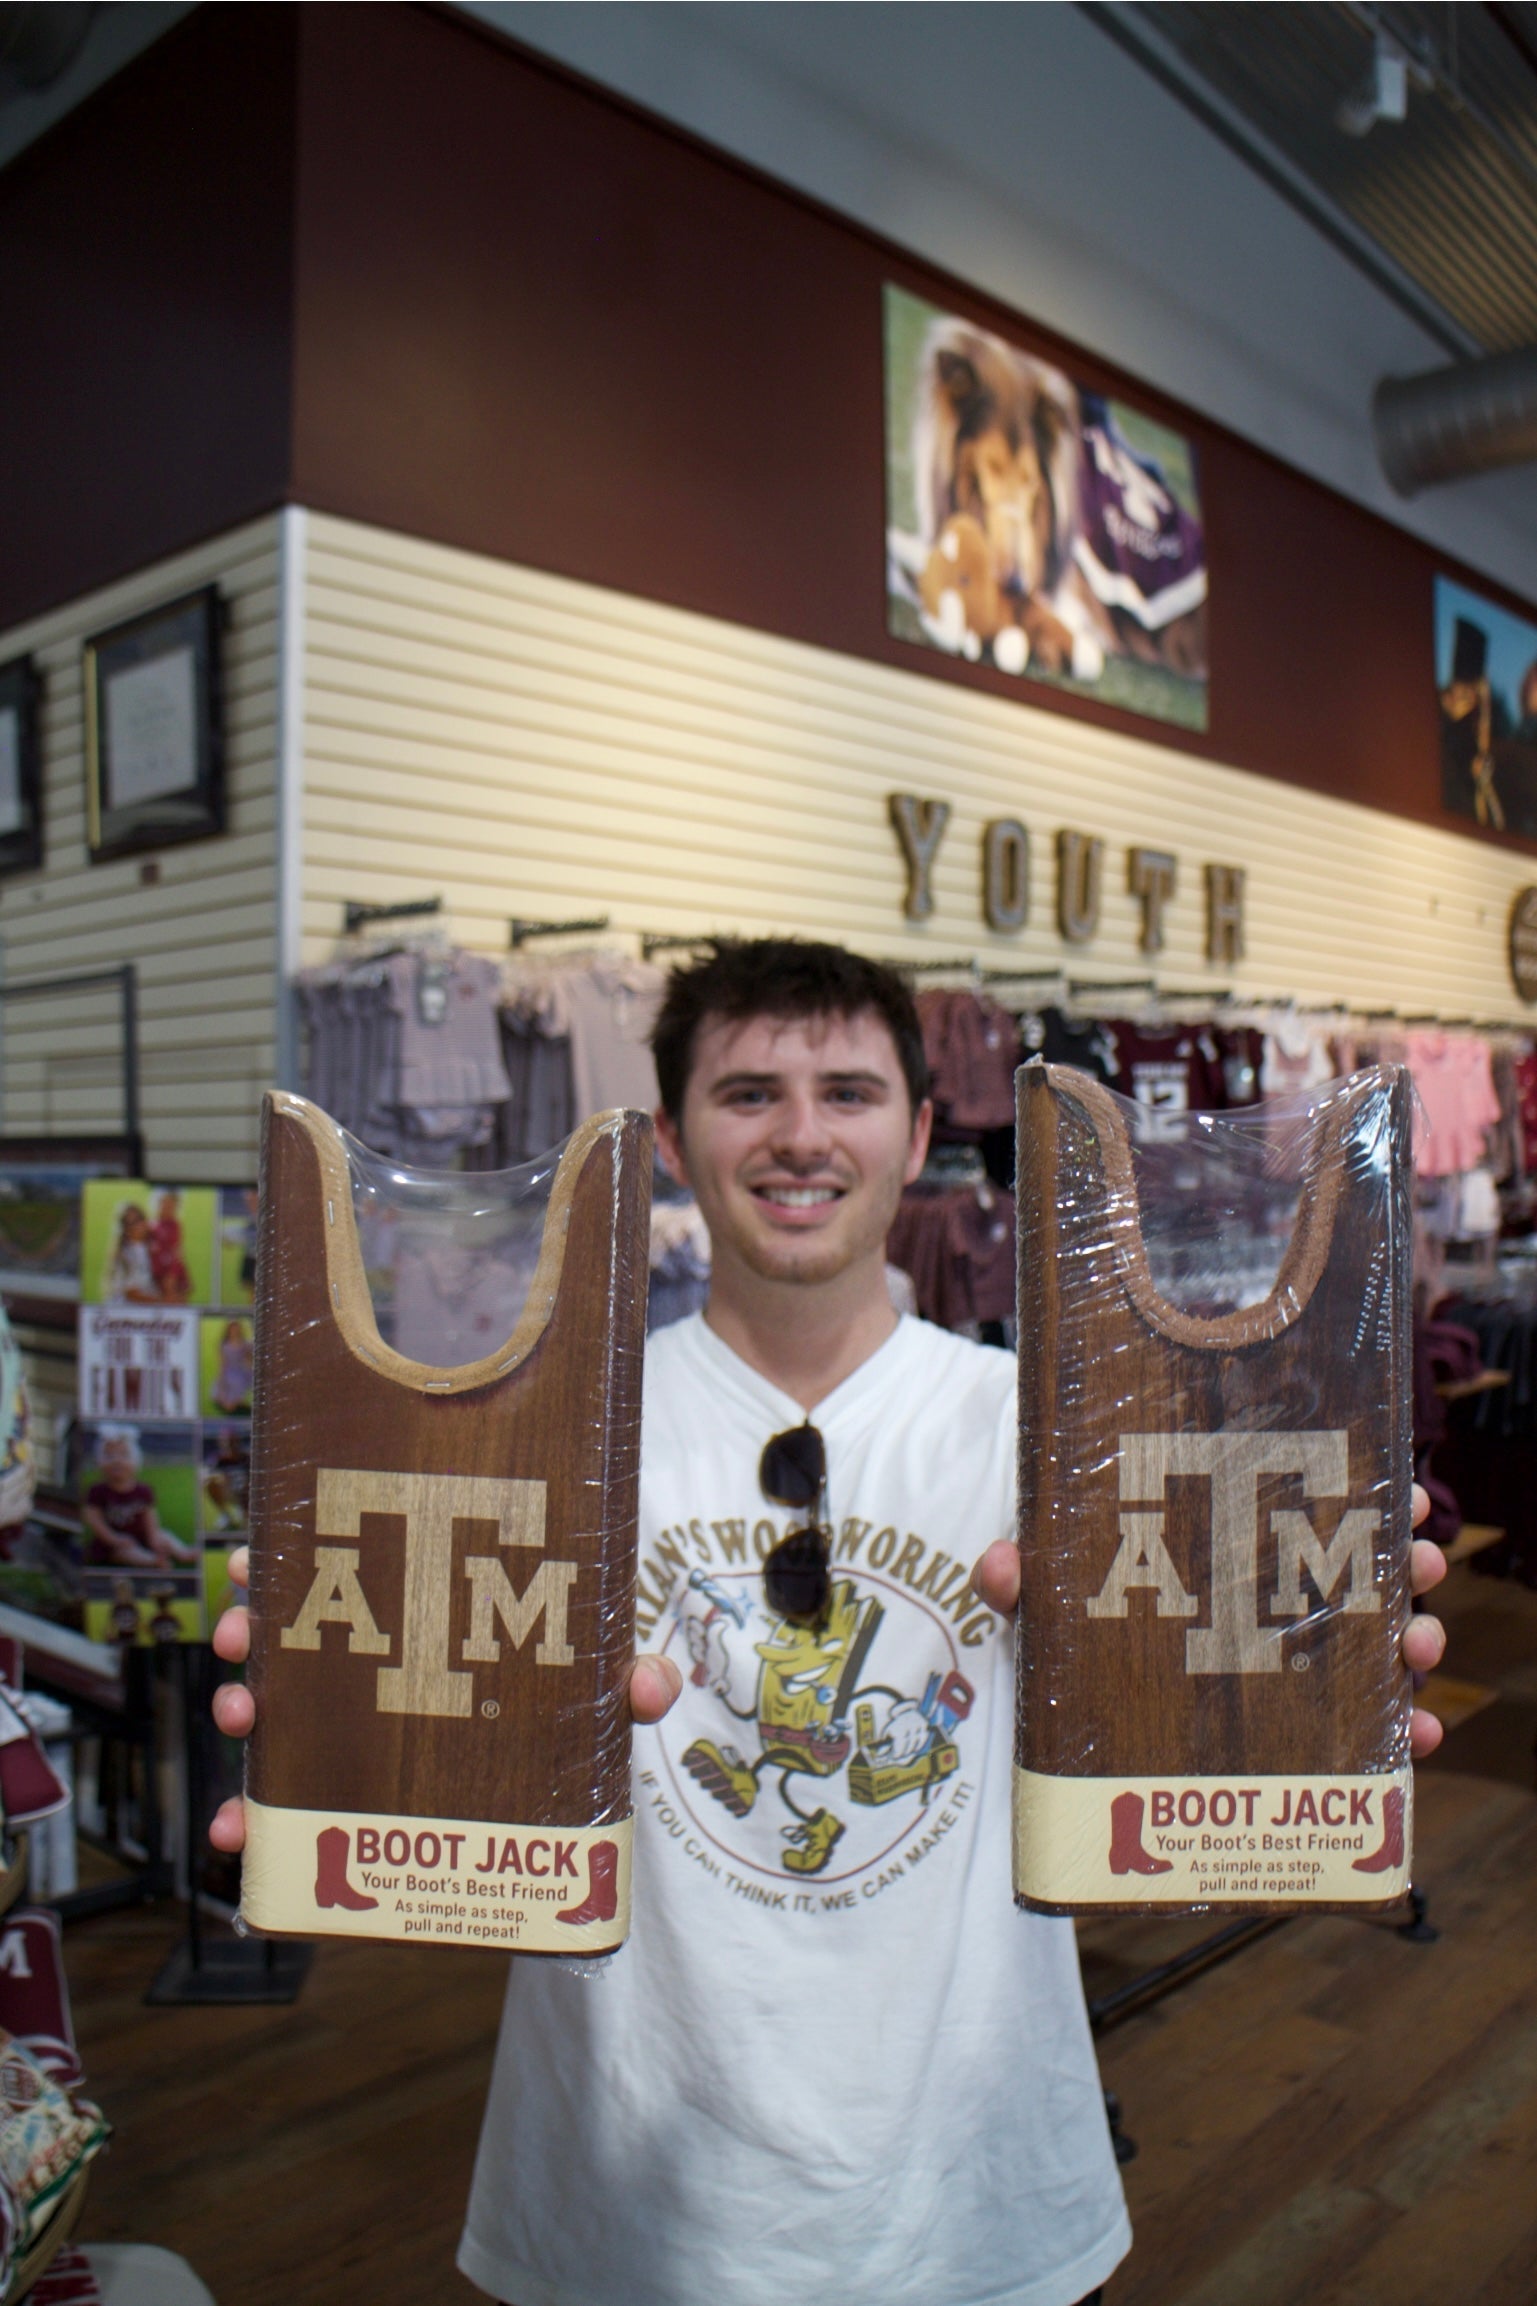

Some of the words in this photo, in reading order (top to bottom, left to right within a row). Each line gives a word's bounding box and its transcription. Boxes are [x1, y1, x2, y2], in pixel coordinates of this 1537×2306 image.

[887, 793, 1246, 963] YOUTH
[1151, 1788, 1261, 1827] BOOT
[1271, 1788, 1374, 1826] JACK
[356, 1828, 466, 1870] BOOT
[475, 1836, 579, 1877] JACK
[639, 1770, 659, 1788] IF
[652, 1793, 687, 1838] YOU
[684, 1838, 722, 1878] CAN
[725, 1872, 788, 1911] THINK
[821, 1890, 858, 1912] WE
[861, 1861, 905, 1898] CAN
[905, 1809, 958, 1868] MAKE
[1156, 1834, 1195, 1850] Your
[1201, 1834, 1256, 1850] Boot's
[1263, 1834, 1301, 1850] Best
[1308, 1833, 1363, 1849] Friend
[1190, 1860, 1208, 1872] As
[1212, 1859, 1261, 1876] simple
[1267, 1862, 1283, 1872] as
[1288, 1860, 1325, 1876] step,
[361, 1872, 400, 1890] Your
[406, 1874, 461, 1895] Boot's
[466, 1880, 505, 1898] Best
[511, 1882, 568, 1901] Friend
[1200, 1877, 1226, 1893] pull
[1231, 1877, 1258, 1891] and
[1263, 1877, 1316, 1893] repeat!
[395, 1899, 413, 1912] As
[417, 1900, 466, 1918] simple
[471, 1907, 488, 1918] as
[492, 1907, 529, 1924] step,
[404, 1918, 431, 1933] pull
[435, 1920, 463, 1935] and
[467, 1923, 520, 1940] repeat!
